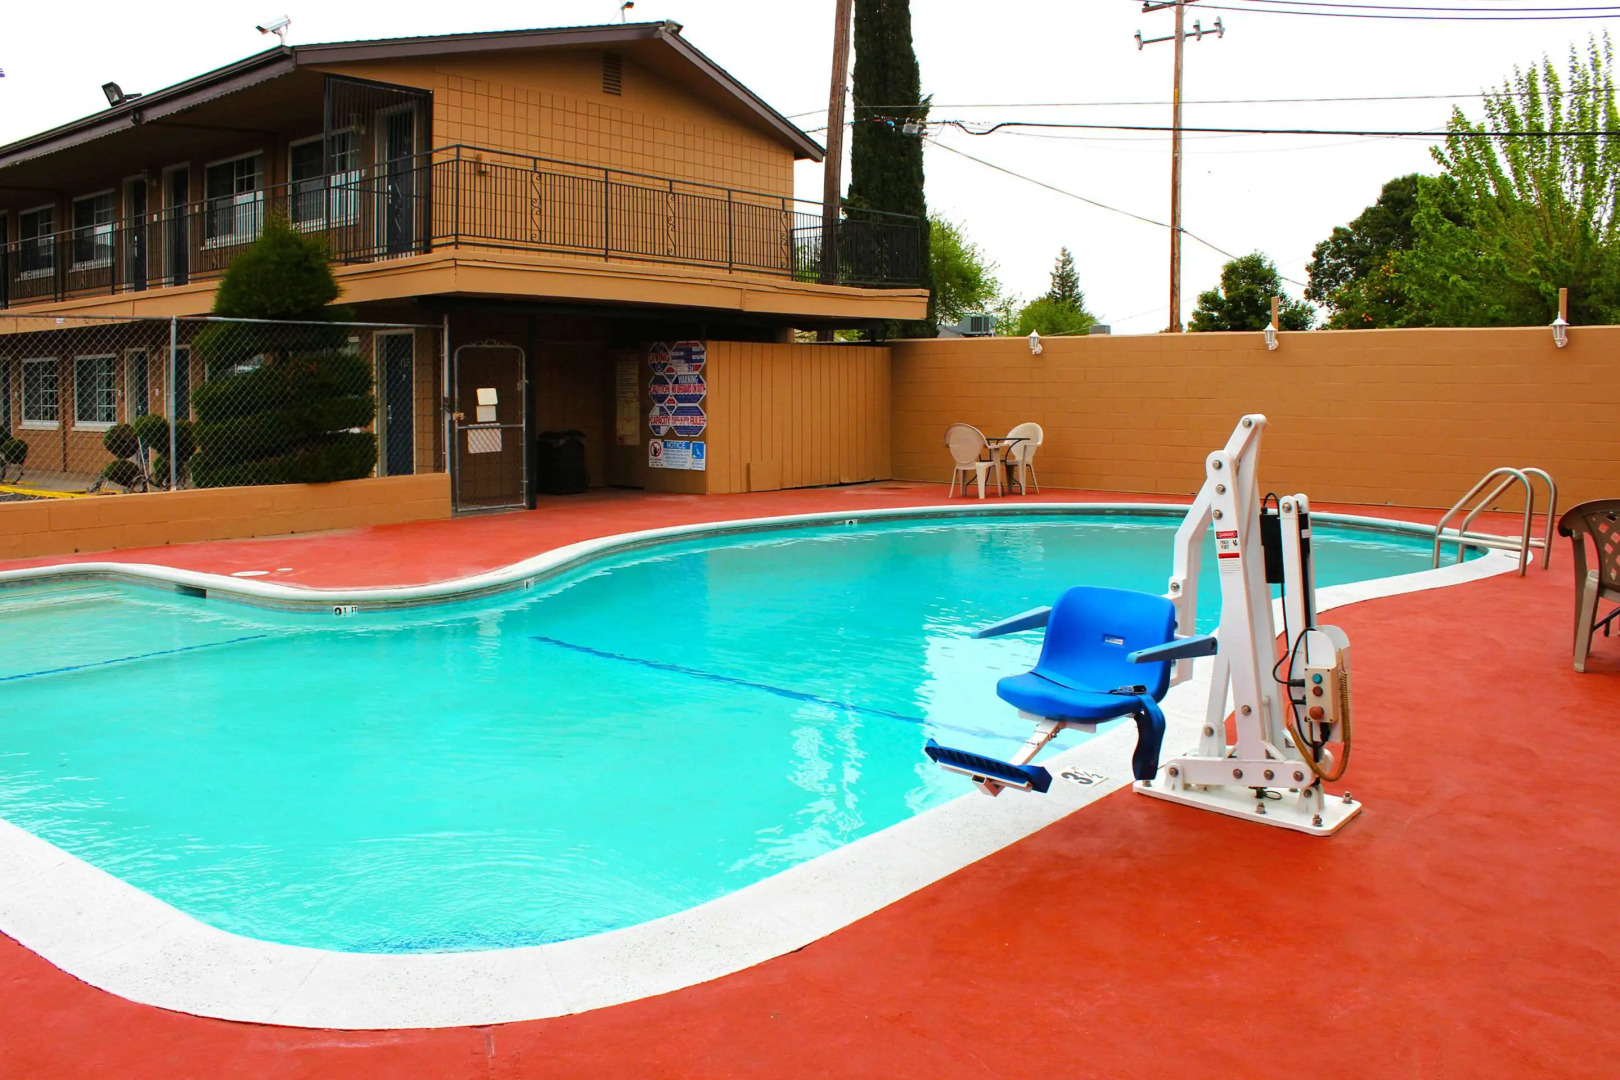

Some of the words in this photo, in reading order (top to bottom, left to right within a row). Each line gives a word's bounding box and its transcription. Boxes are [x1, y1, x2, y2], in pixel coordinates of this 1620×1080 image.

[678, 375, 698, 384] WARNING
[651, 416, 670, 425] CAPACITY
[690, 416, 705, 425] RULES
[666, 441, 686, 449] NOTICE
